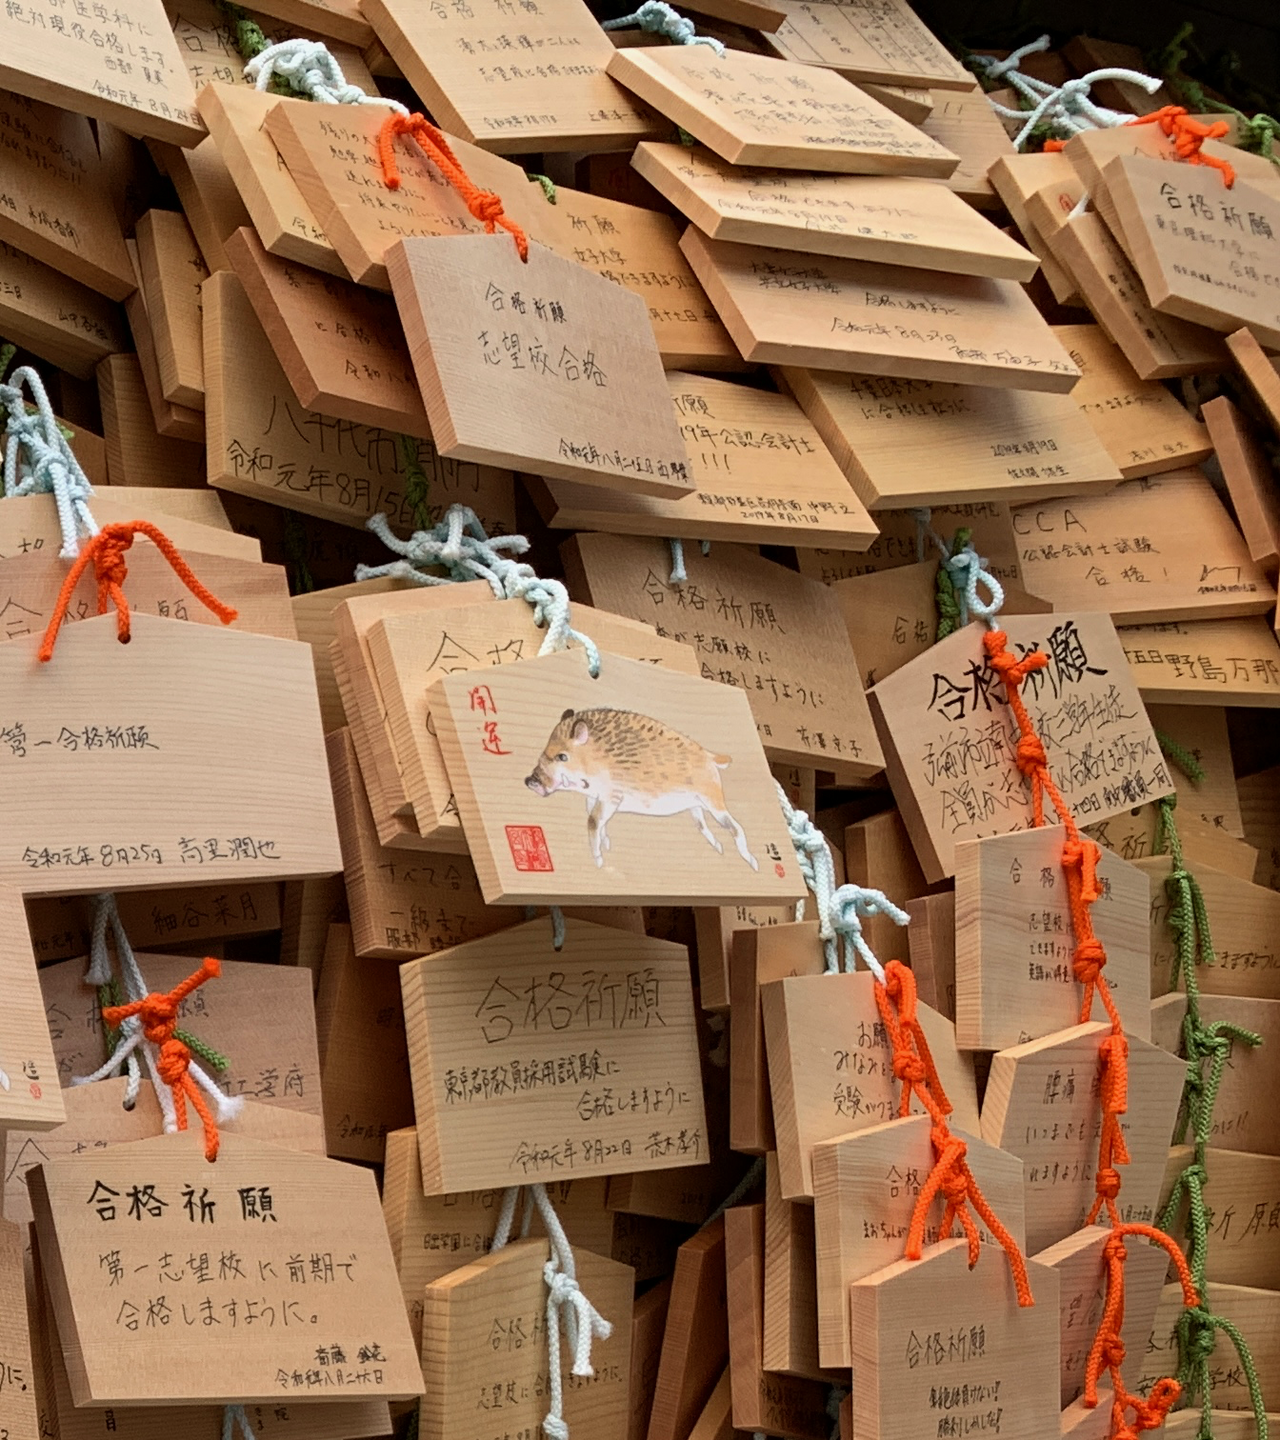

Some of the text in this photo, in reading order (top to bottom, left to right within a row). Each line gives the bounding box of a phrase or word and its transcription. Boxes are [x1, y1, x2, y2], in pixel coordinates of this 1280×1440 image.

[642, 568, 786, 636] 合格祈願
[475, 966, 667, 1044] 合格祈願
[86, 1179, 279, 1224] 合格祈願
[99, 1251, 360, 1287] 第一志望校に前期で
[115, 1296, 321, 1332] 合格しますように。
[905, 1324, 987, 1370] 合格祈願
